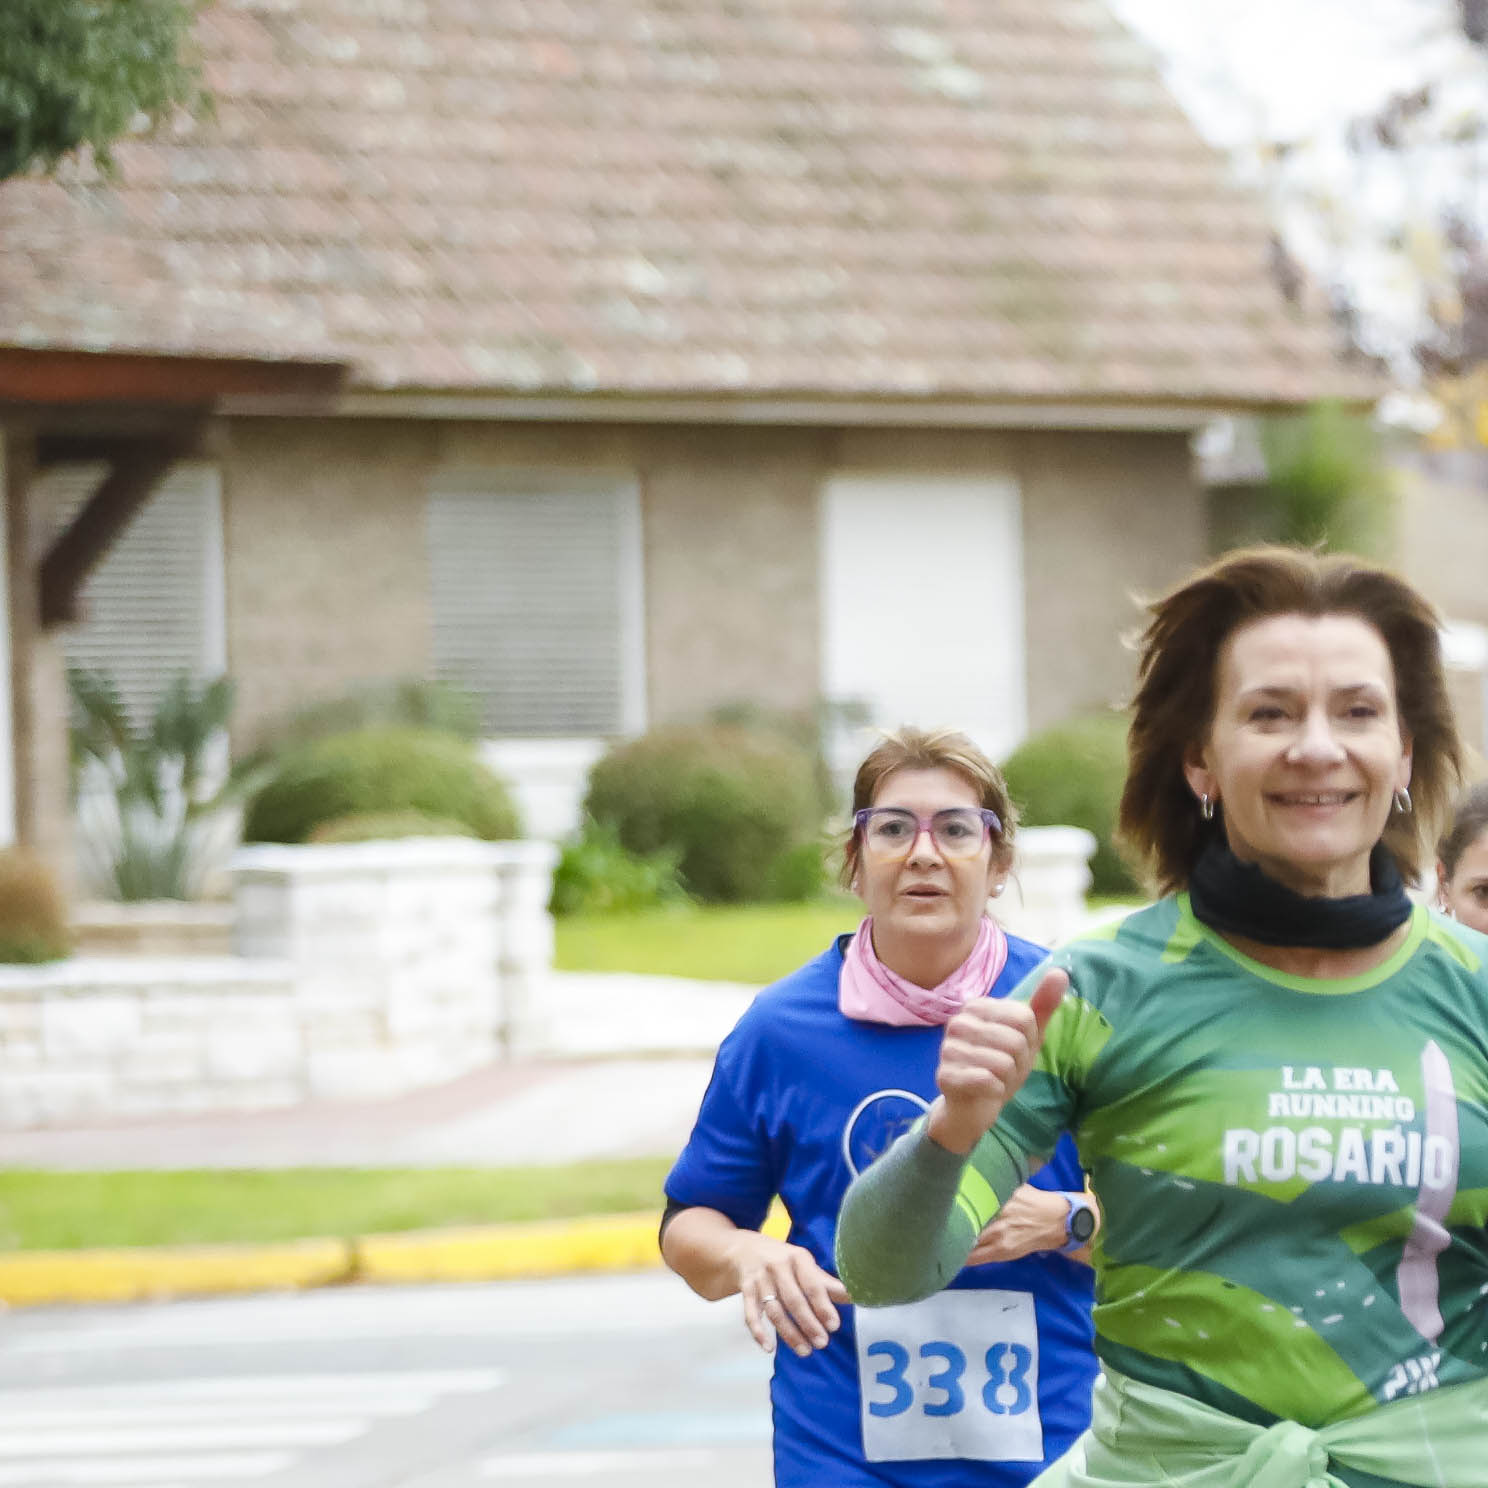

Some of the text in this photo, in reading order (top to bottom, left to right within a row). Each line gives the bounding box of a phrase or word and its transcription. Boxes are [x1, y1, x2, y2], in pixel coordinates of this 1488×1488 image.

[1281, 1066, 1399, 1092] LA ERA
[1267, 1093, 1415, 1121] RUNNING
[1222, 1124, 1454, 1190] ROSARIO
[867, 1340, 1033, 1417] 338
